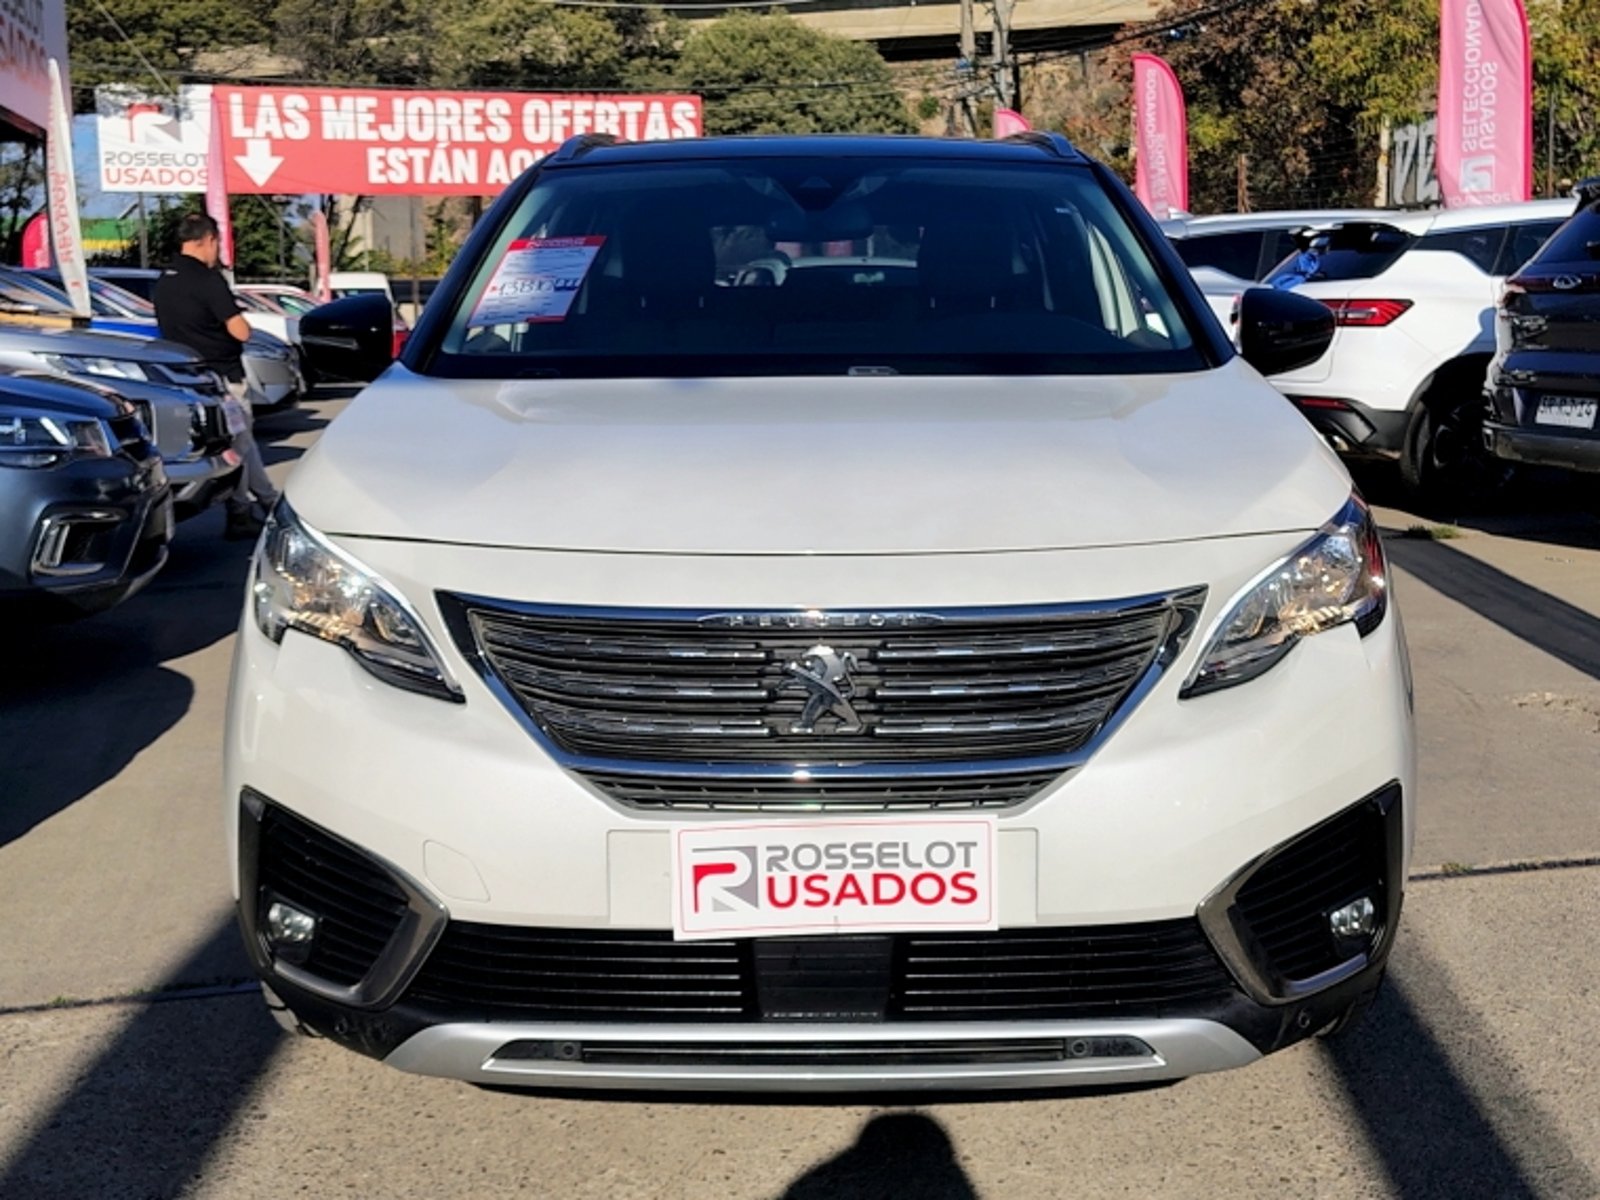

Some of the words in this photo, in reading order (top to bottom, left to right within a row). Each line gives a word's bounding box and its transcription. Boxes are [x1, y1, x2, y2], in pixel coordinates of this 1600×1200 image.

[229, 93, 311, 140] LAS
[320, 95, 512, 143] MEJORES
[522, 98, 698, 143] OFERTAS
[104, 151, 208, 167] ROSSELOT
[367, 141, 478, 184] ESTÁN
[104, 167, 208, 187] USADOS
[765, 841, 978, 871] ROSSELOT
[767, 871, 978, 908] USADOS
